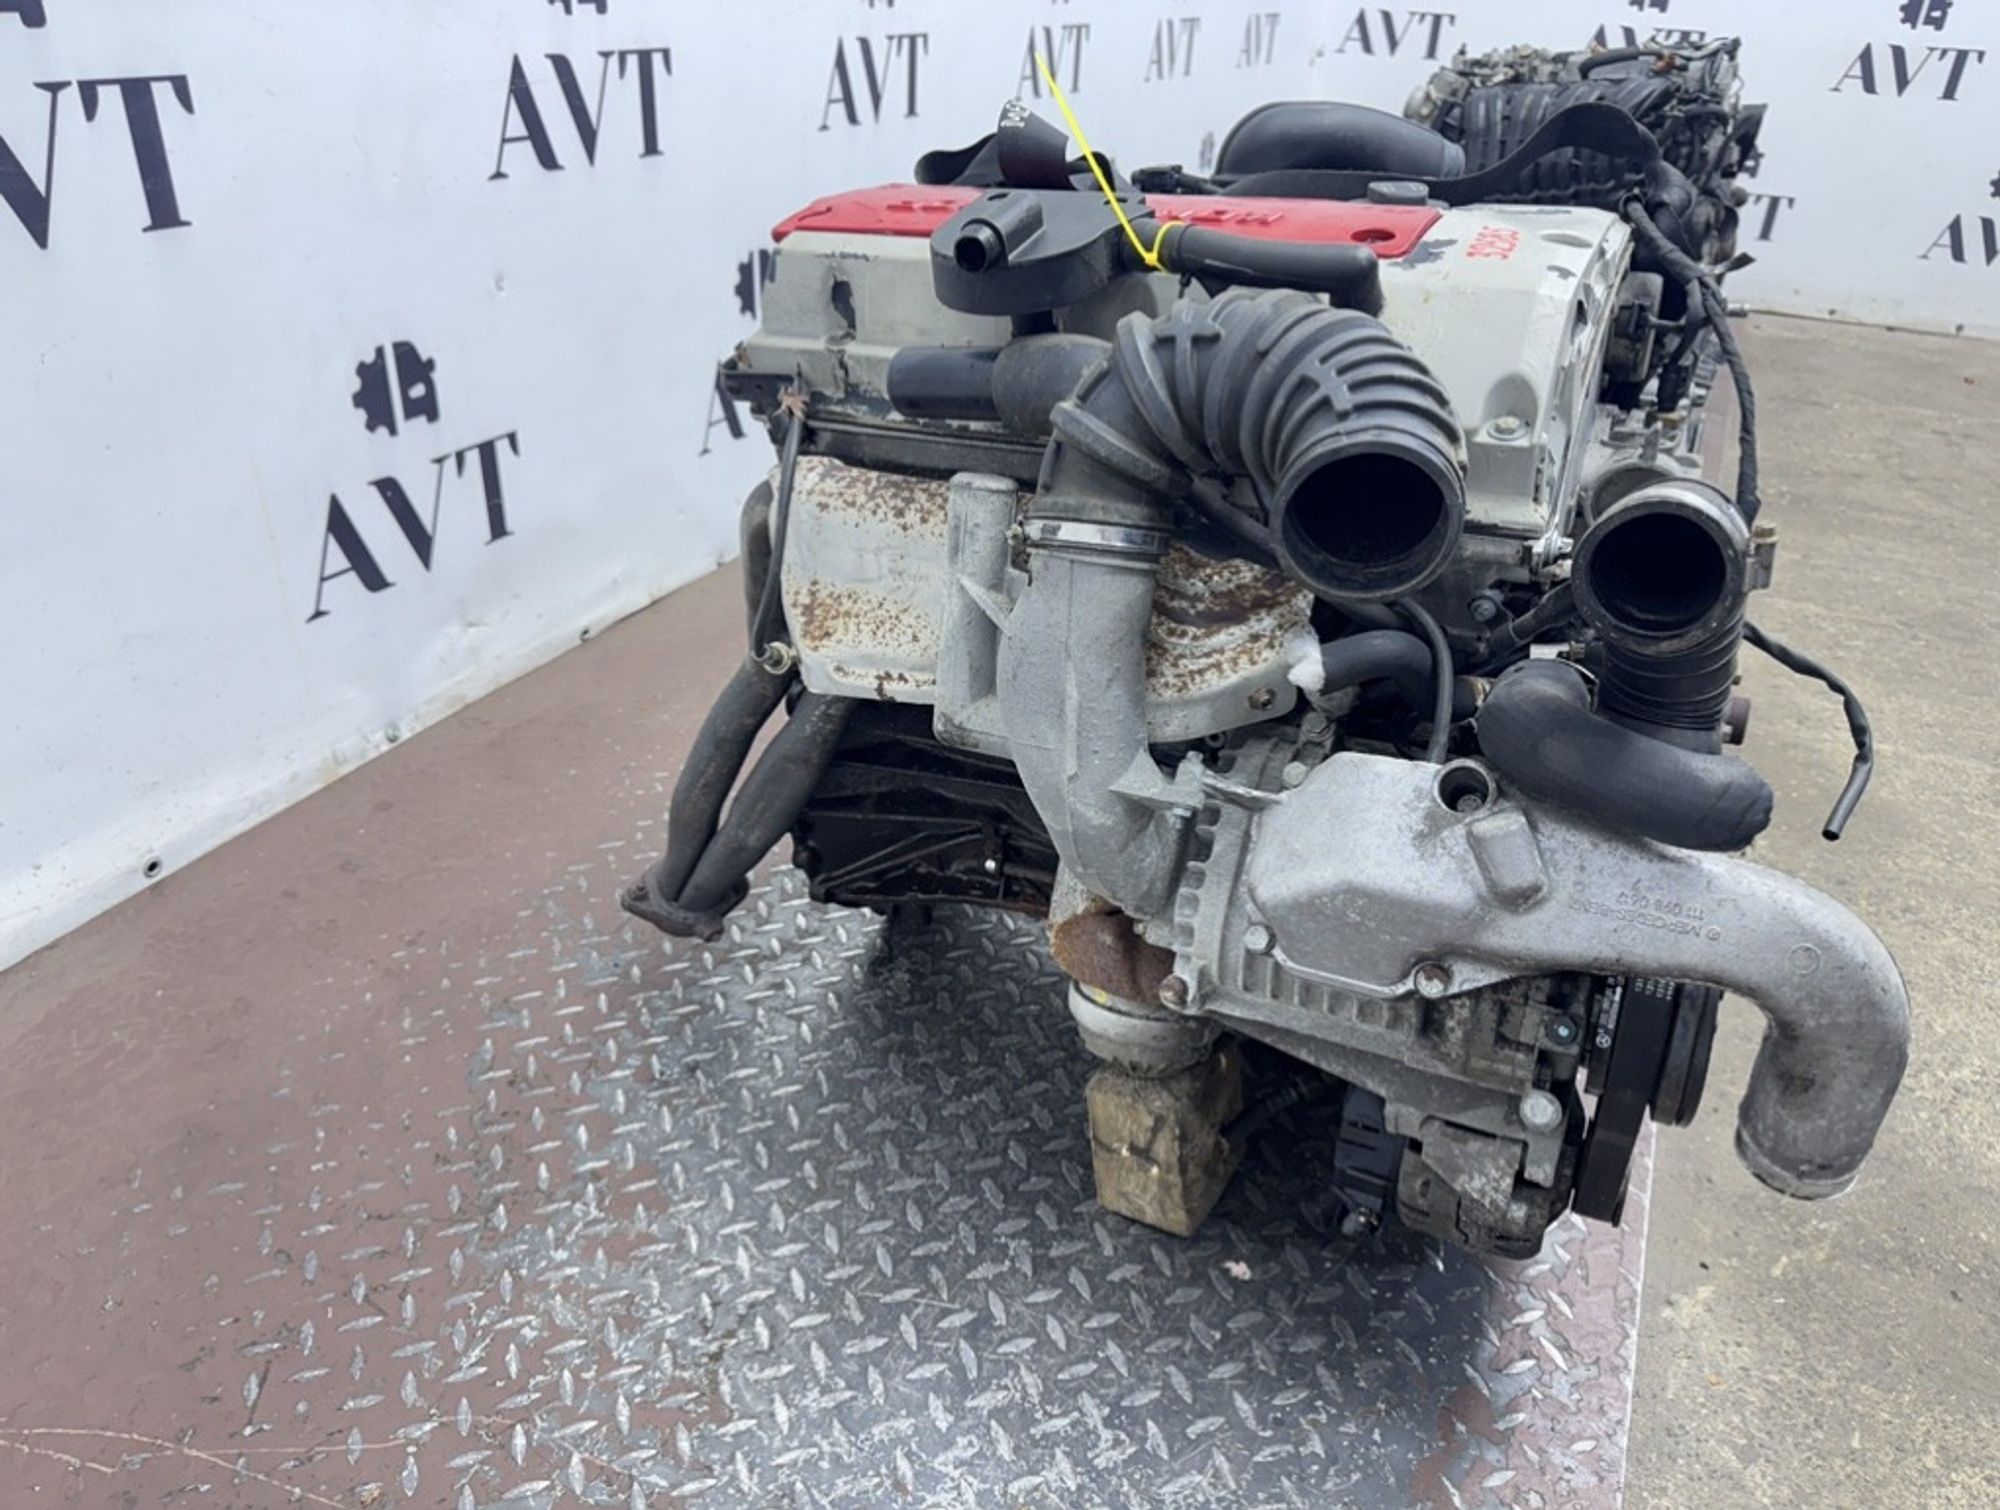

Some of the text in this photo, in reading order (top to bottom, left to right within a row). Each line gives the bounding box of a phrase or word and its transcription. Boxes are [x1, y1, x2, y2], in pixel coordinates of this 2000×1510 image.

[1015, 24, 1090, 102] AVT
[1144, 17, 1201, 82] AVT
[1236, 13, 1281, 69] AVT
[1335, 7, 1456, 60] AVT
[818, 33, 929, 131] AVT
[1829, 42, 1985, 101] AVT
[488, 48, 672, 180] AVT
[305, 431, 520, 623] AVT
